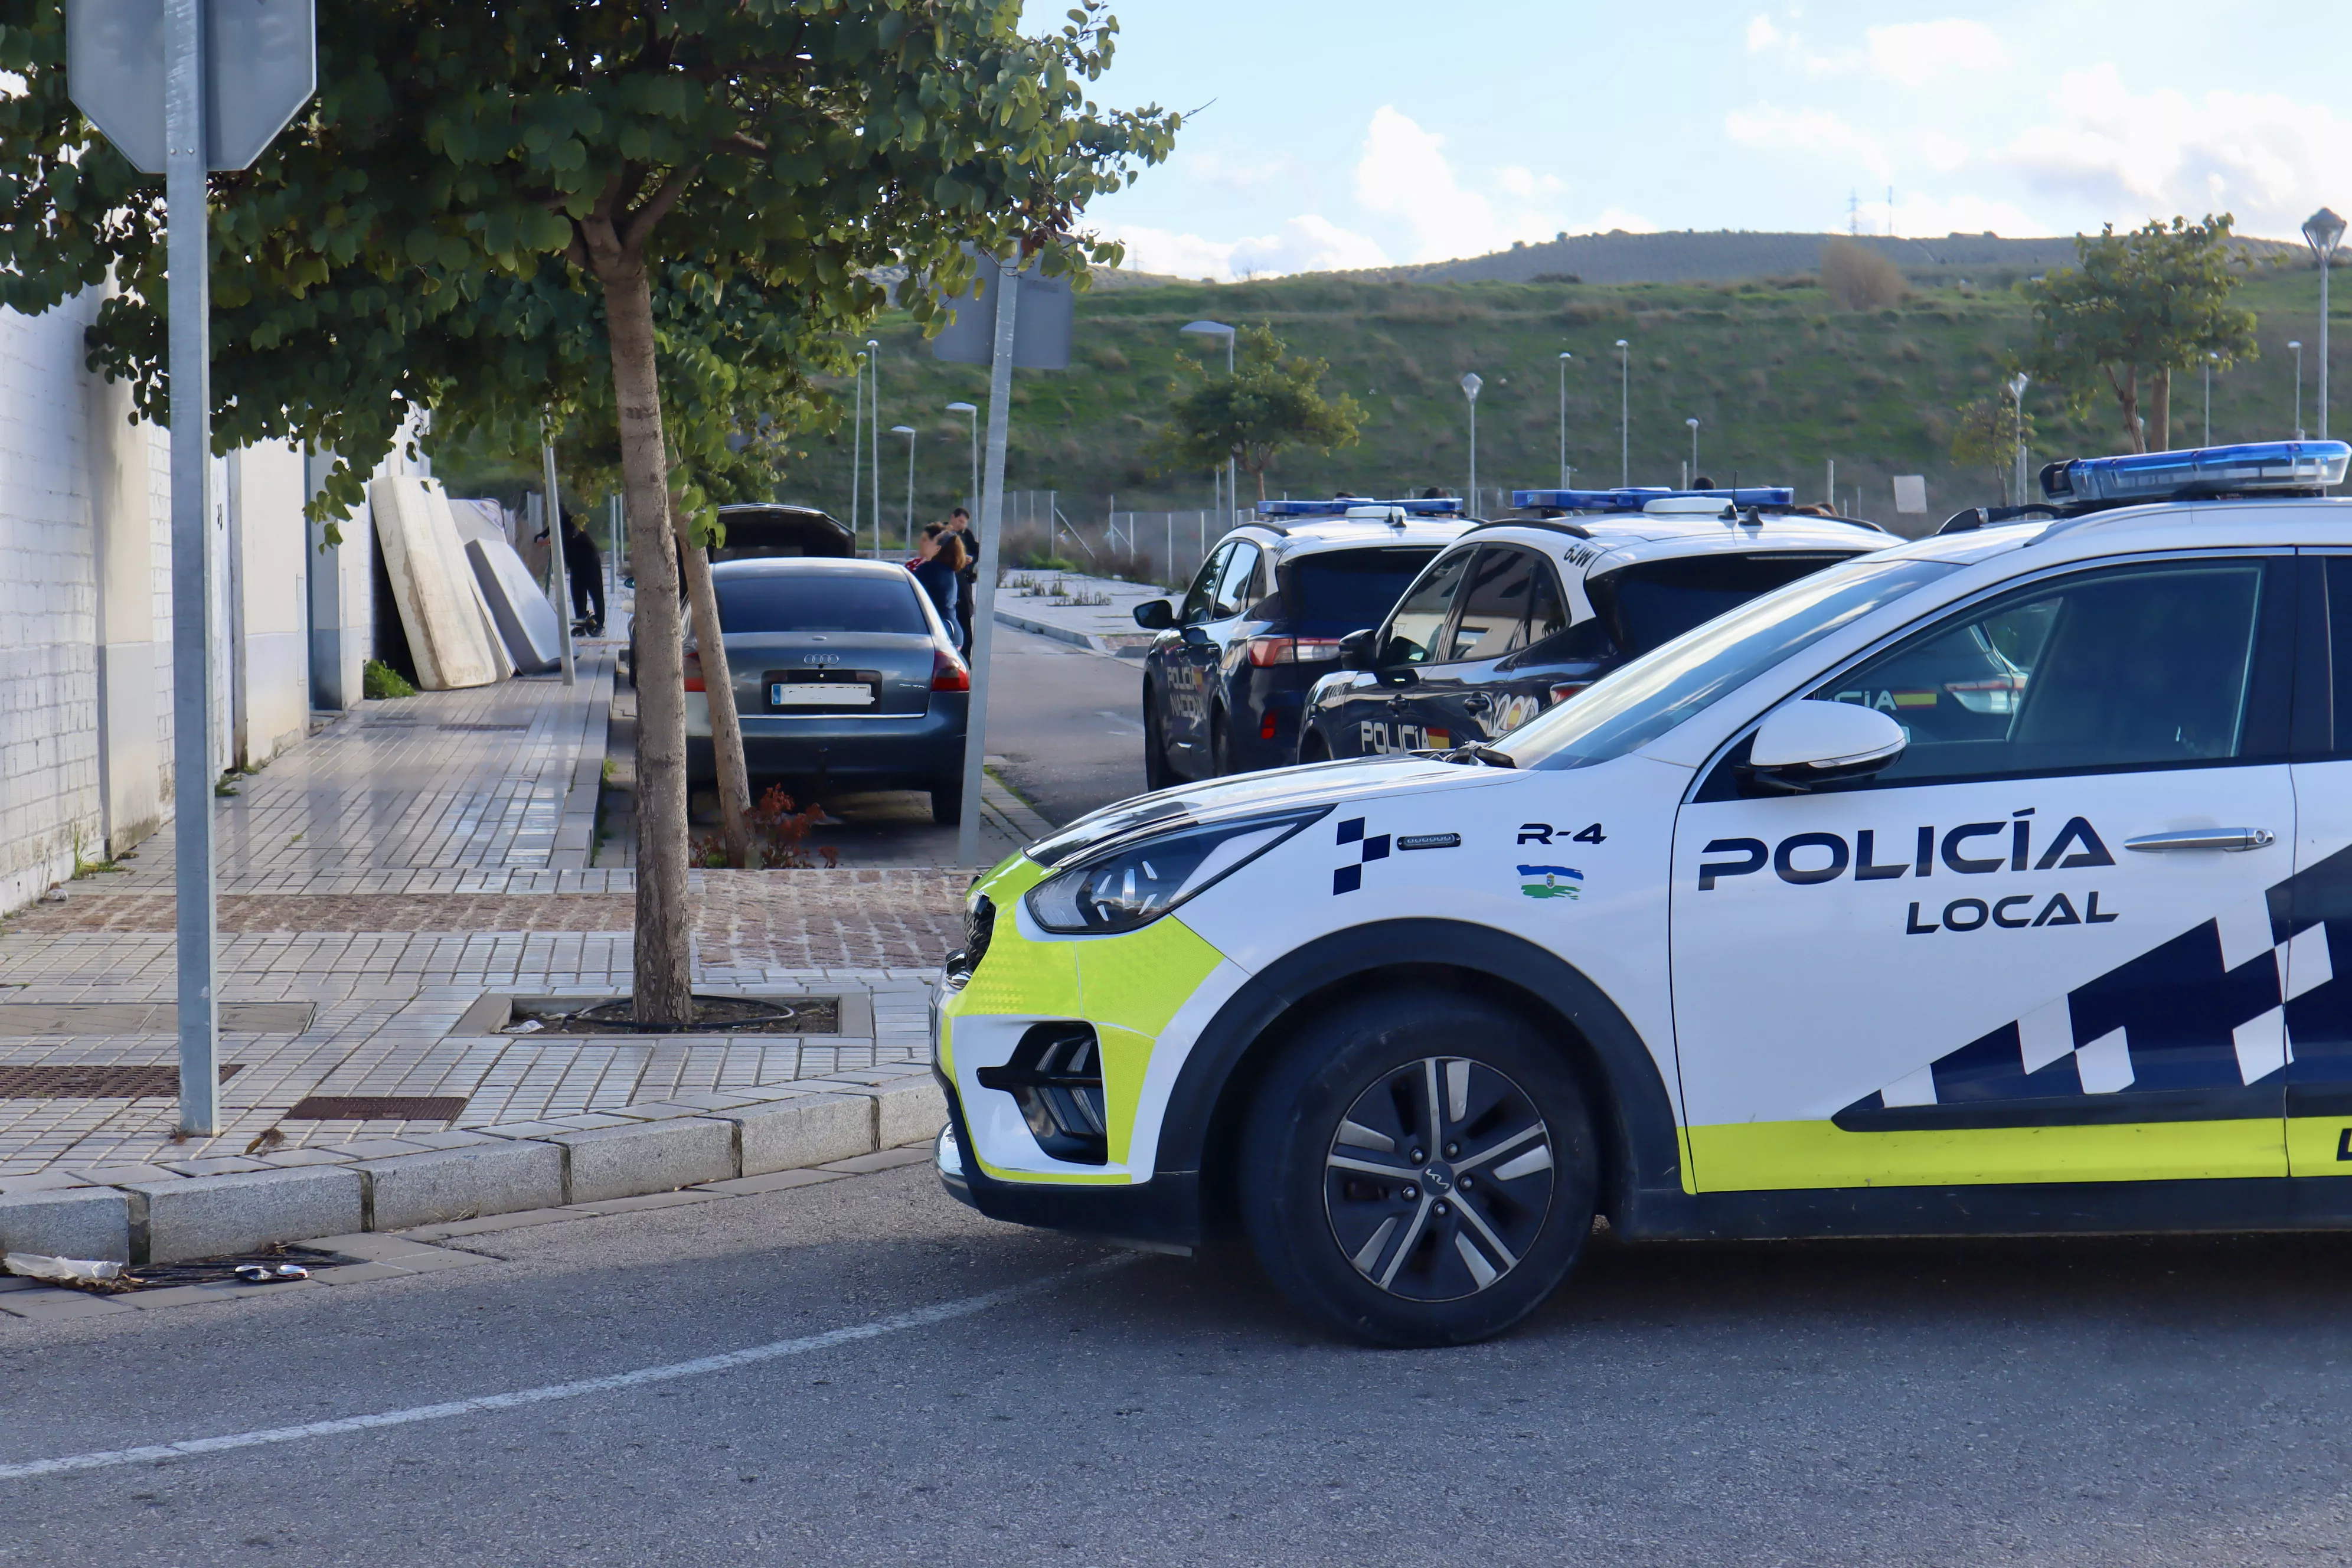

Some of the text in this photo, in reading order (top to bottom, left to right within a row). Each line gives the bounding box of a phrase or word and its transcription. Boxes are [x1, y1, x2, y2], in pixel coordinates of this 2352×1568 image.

[1563, 543, 1596, 568] 6JW
[1517, 823, 1608, 845] R-4
[1698, 807, 2115, 891] POLICÍA
[1906, 891, 2118, 935] LOCAL
